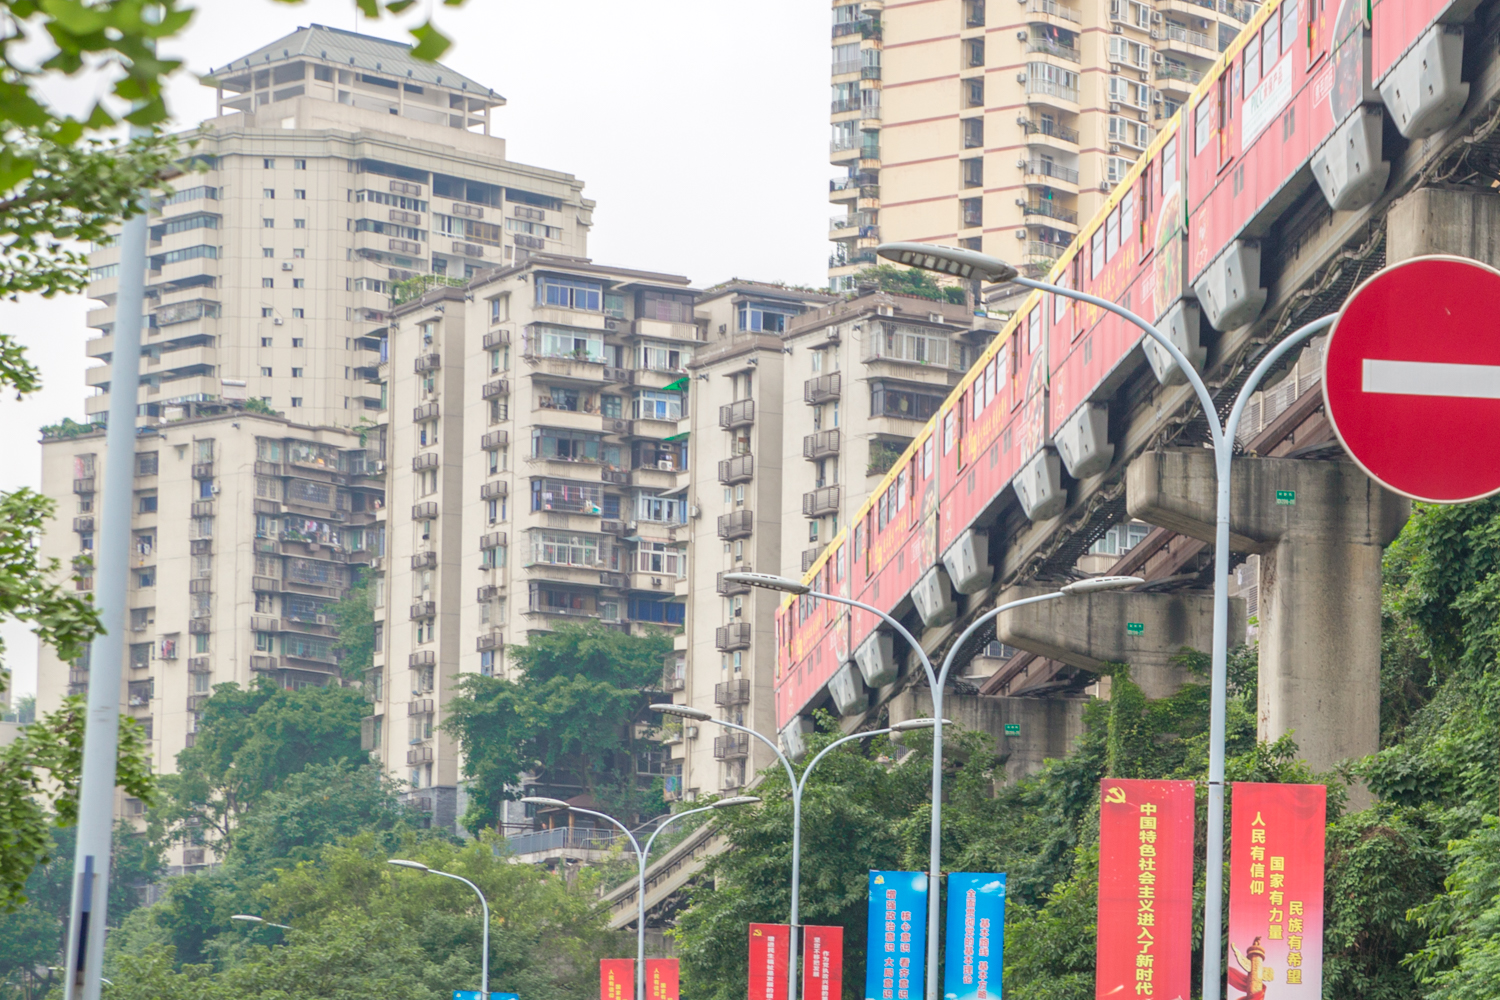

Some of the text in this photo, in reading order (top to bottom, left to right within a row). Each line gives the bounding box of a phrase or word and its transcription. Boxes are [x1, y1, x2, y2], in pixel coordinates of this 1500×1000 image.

[1250, 811, 1266, 896] 人民有信仰
[962, 888, 976, 985] 全面贯彻党的基本理论
[1135, 802, 1158, 996] 中国特色社会主义进入了新时代
[1268, 856, 1285, 940] 国家有力量
[883, 889, 897, 999] 增强政治意识 大局意识
[898, 911, 912, 999] 核心意识 看齐意识
[977, 918, 991, 999] 基本路线 基本方略
[1286, 901, 1304, 985] 民族有希望
